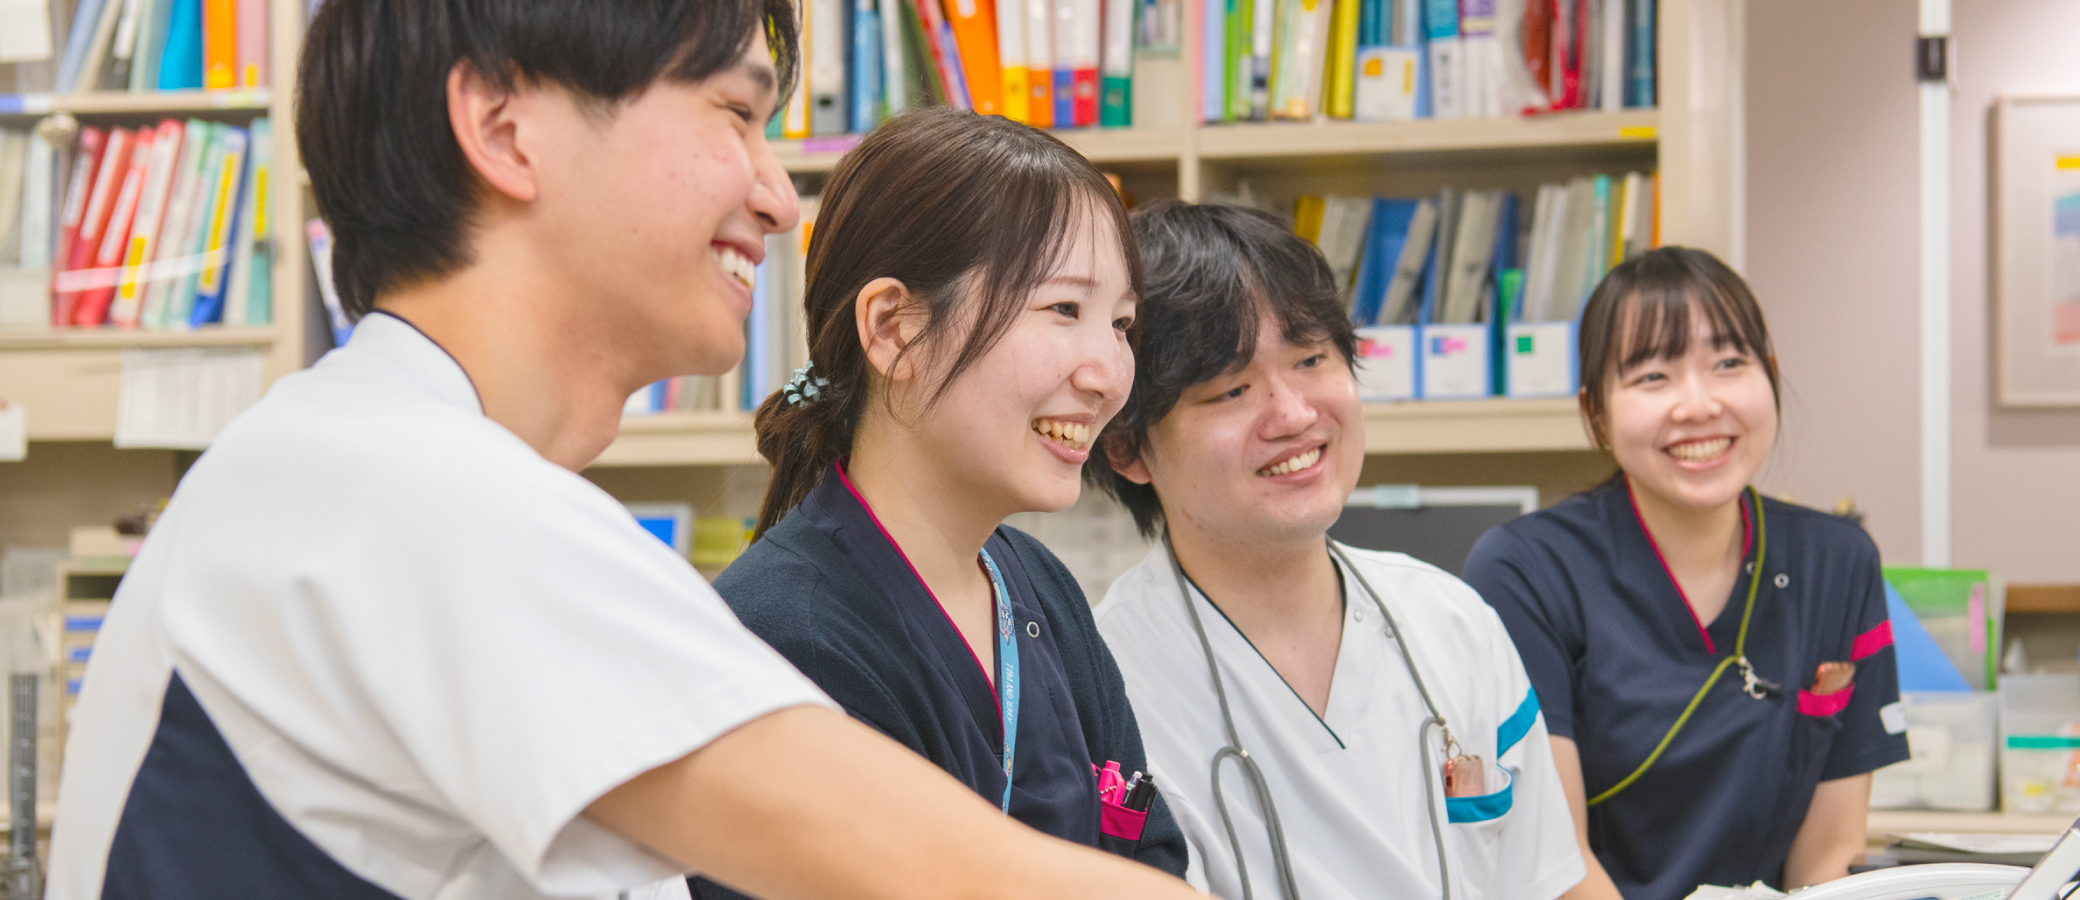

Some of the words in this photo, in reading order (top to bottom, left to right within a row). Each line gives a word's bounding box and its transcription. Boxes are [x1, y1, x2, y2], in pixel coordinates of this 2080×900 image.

[1005, 663, 1014, 682] TOM
[1005, 681, 1014, 699] AND
[1005, 698, 1013, 724] JERRY
